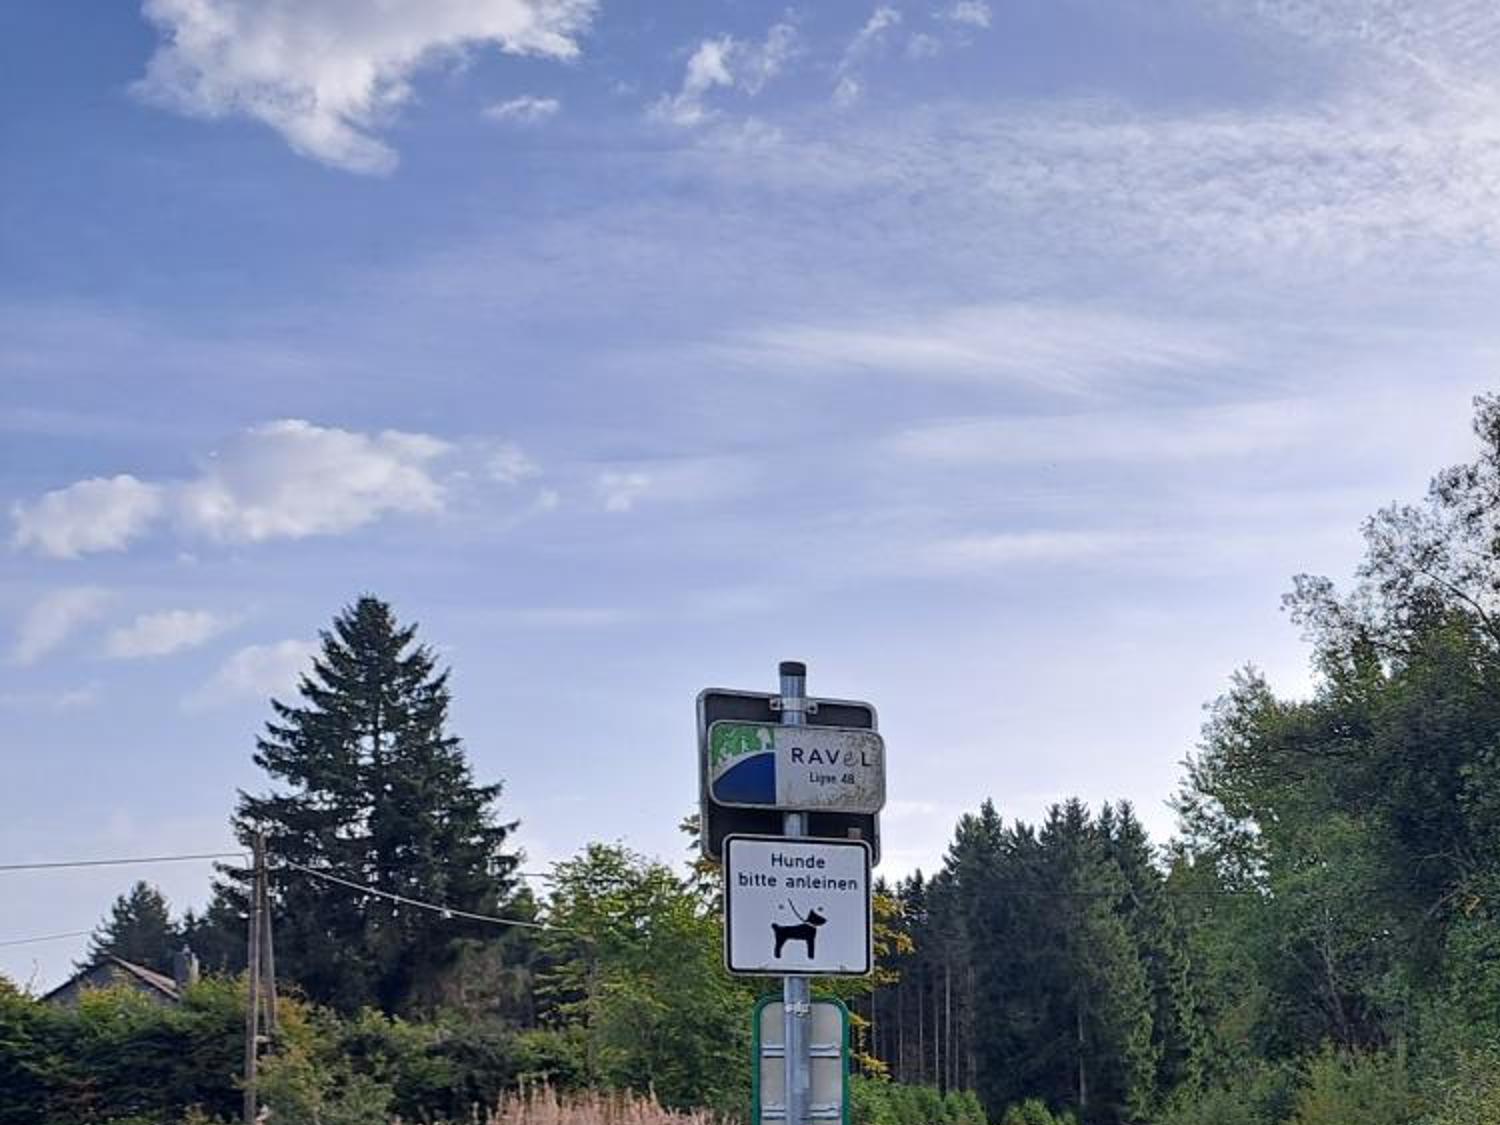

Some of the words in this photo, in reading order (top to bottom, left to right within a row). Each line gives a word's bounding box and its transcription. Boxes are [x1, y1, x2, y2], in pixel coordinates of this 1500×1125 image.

[841, 773, 855, 785] 48
[771, 852, 826, 869] Hunde
[738, 871, 777, 887] bitte
[785, 874, 858, 890] anleinen
